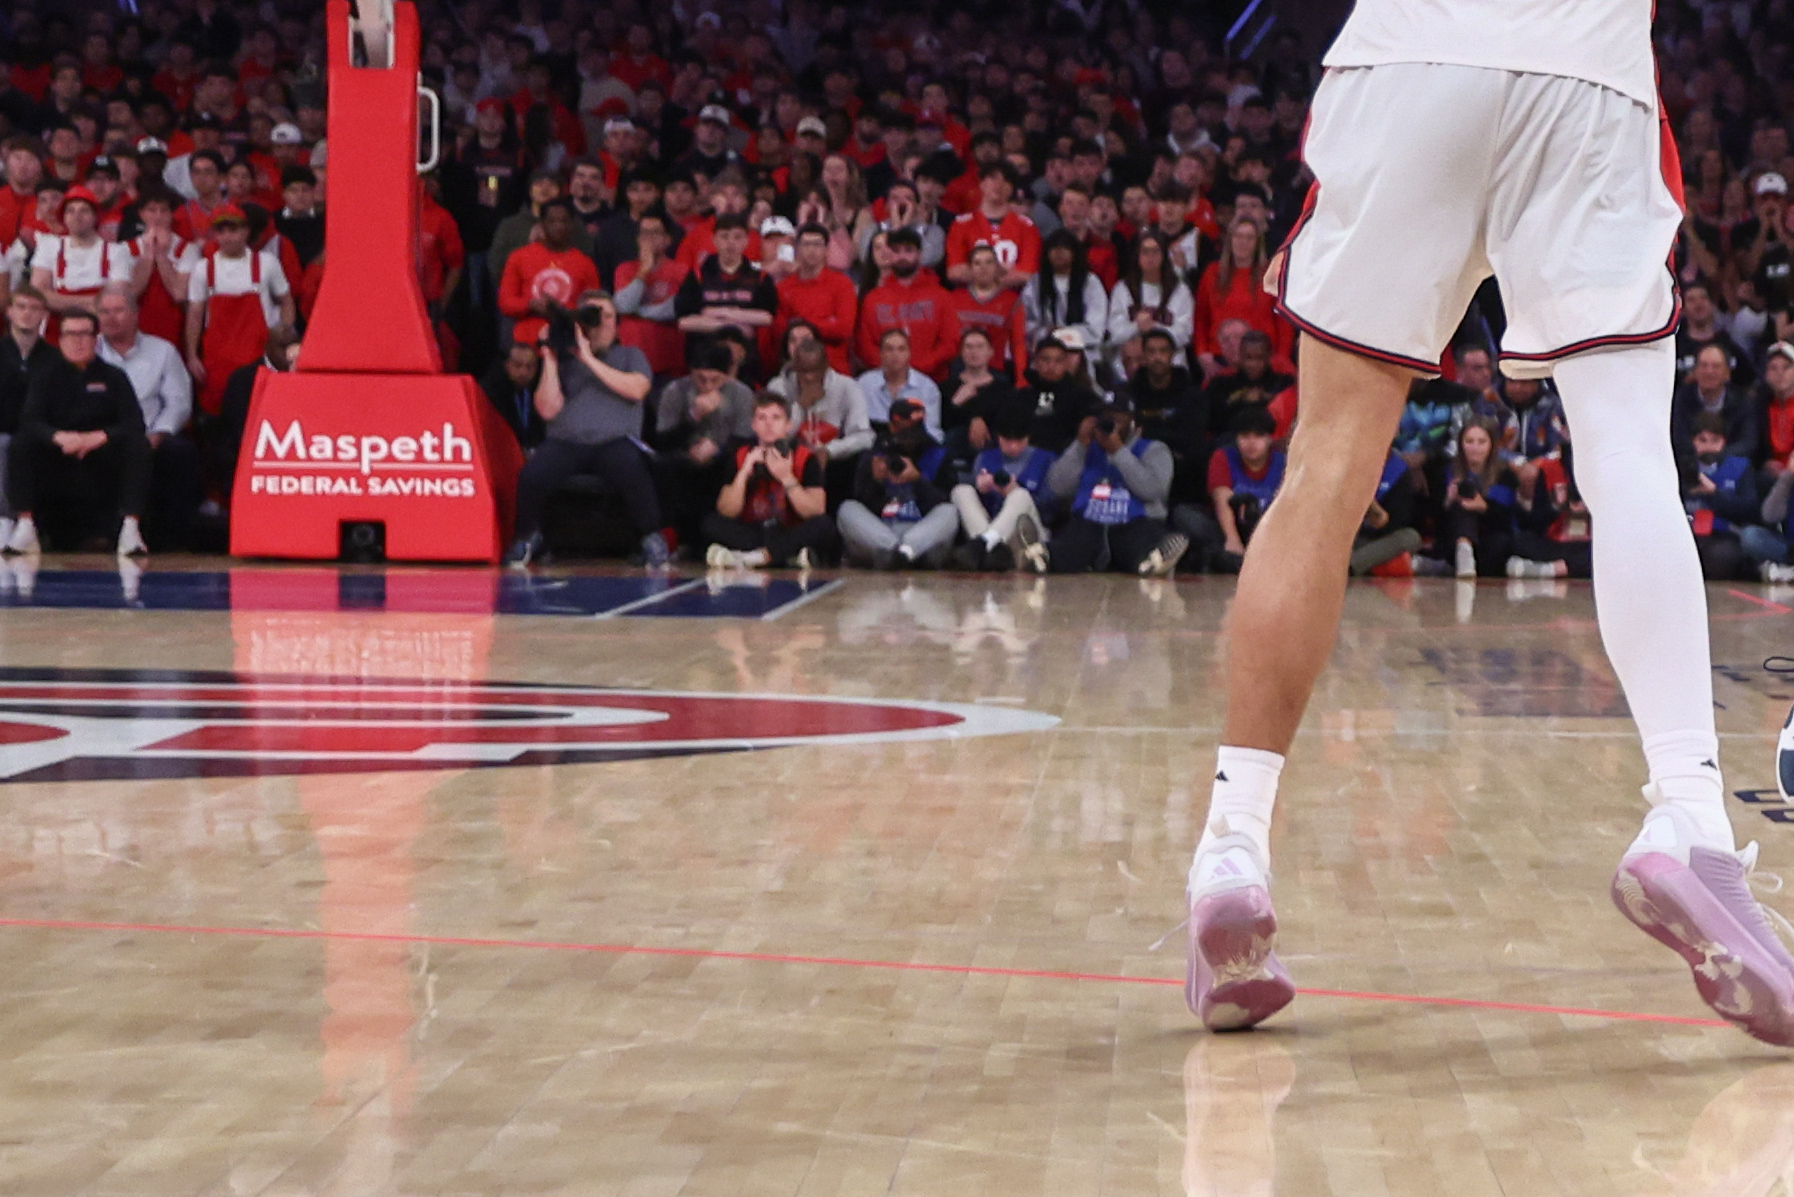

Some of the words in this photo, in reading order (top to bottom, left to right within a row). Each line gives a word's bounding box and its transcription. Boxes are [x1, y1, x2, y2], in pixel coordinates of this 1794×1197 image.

[254, 419, 473, 475] Maspeth
[250, 474, 364, 496] FEDERAL
[367, 477, 476, 498] SAVINGS
